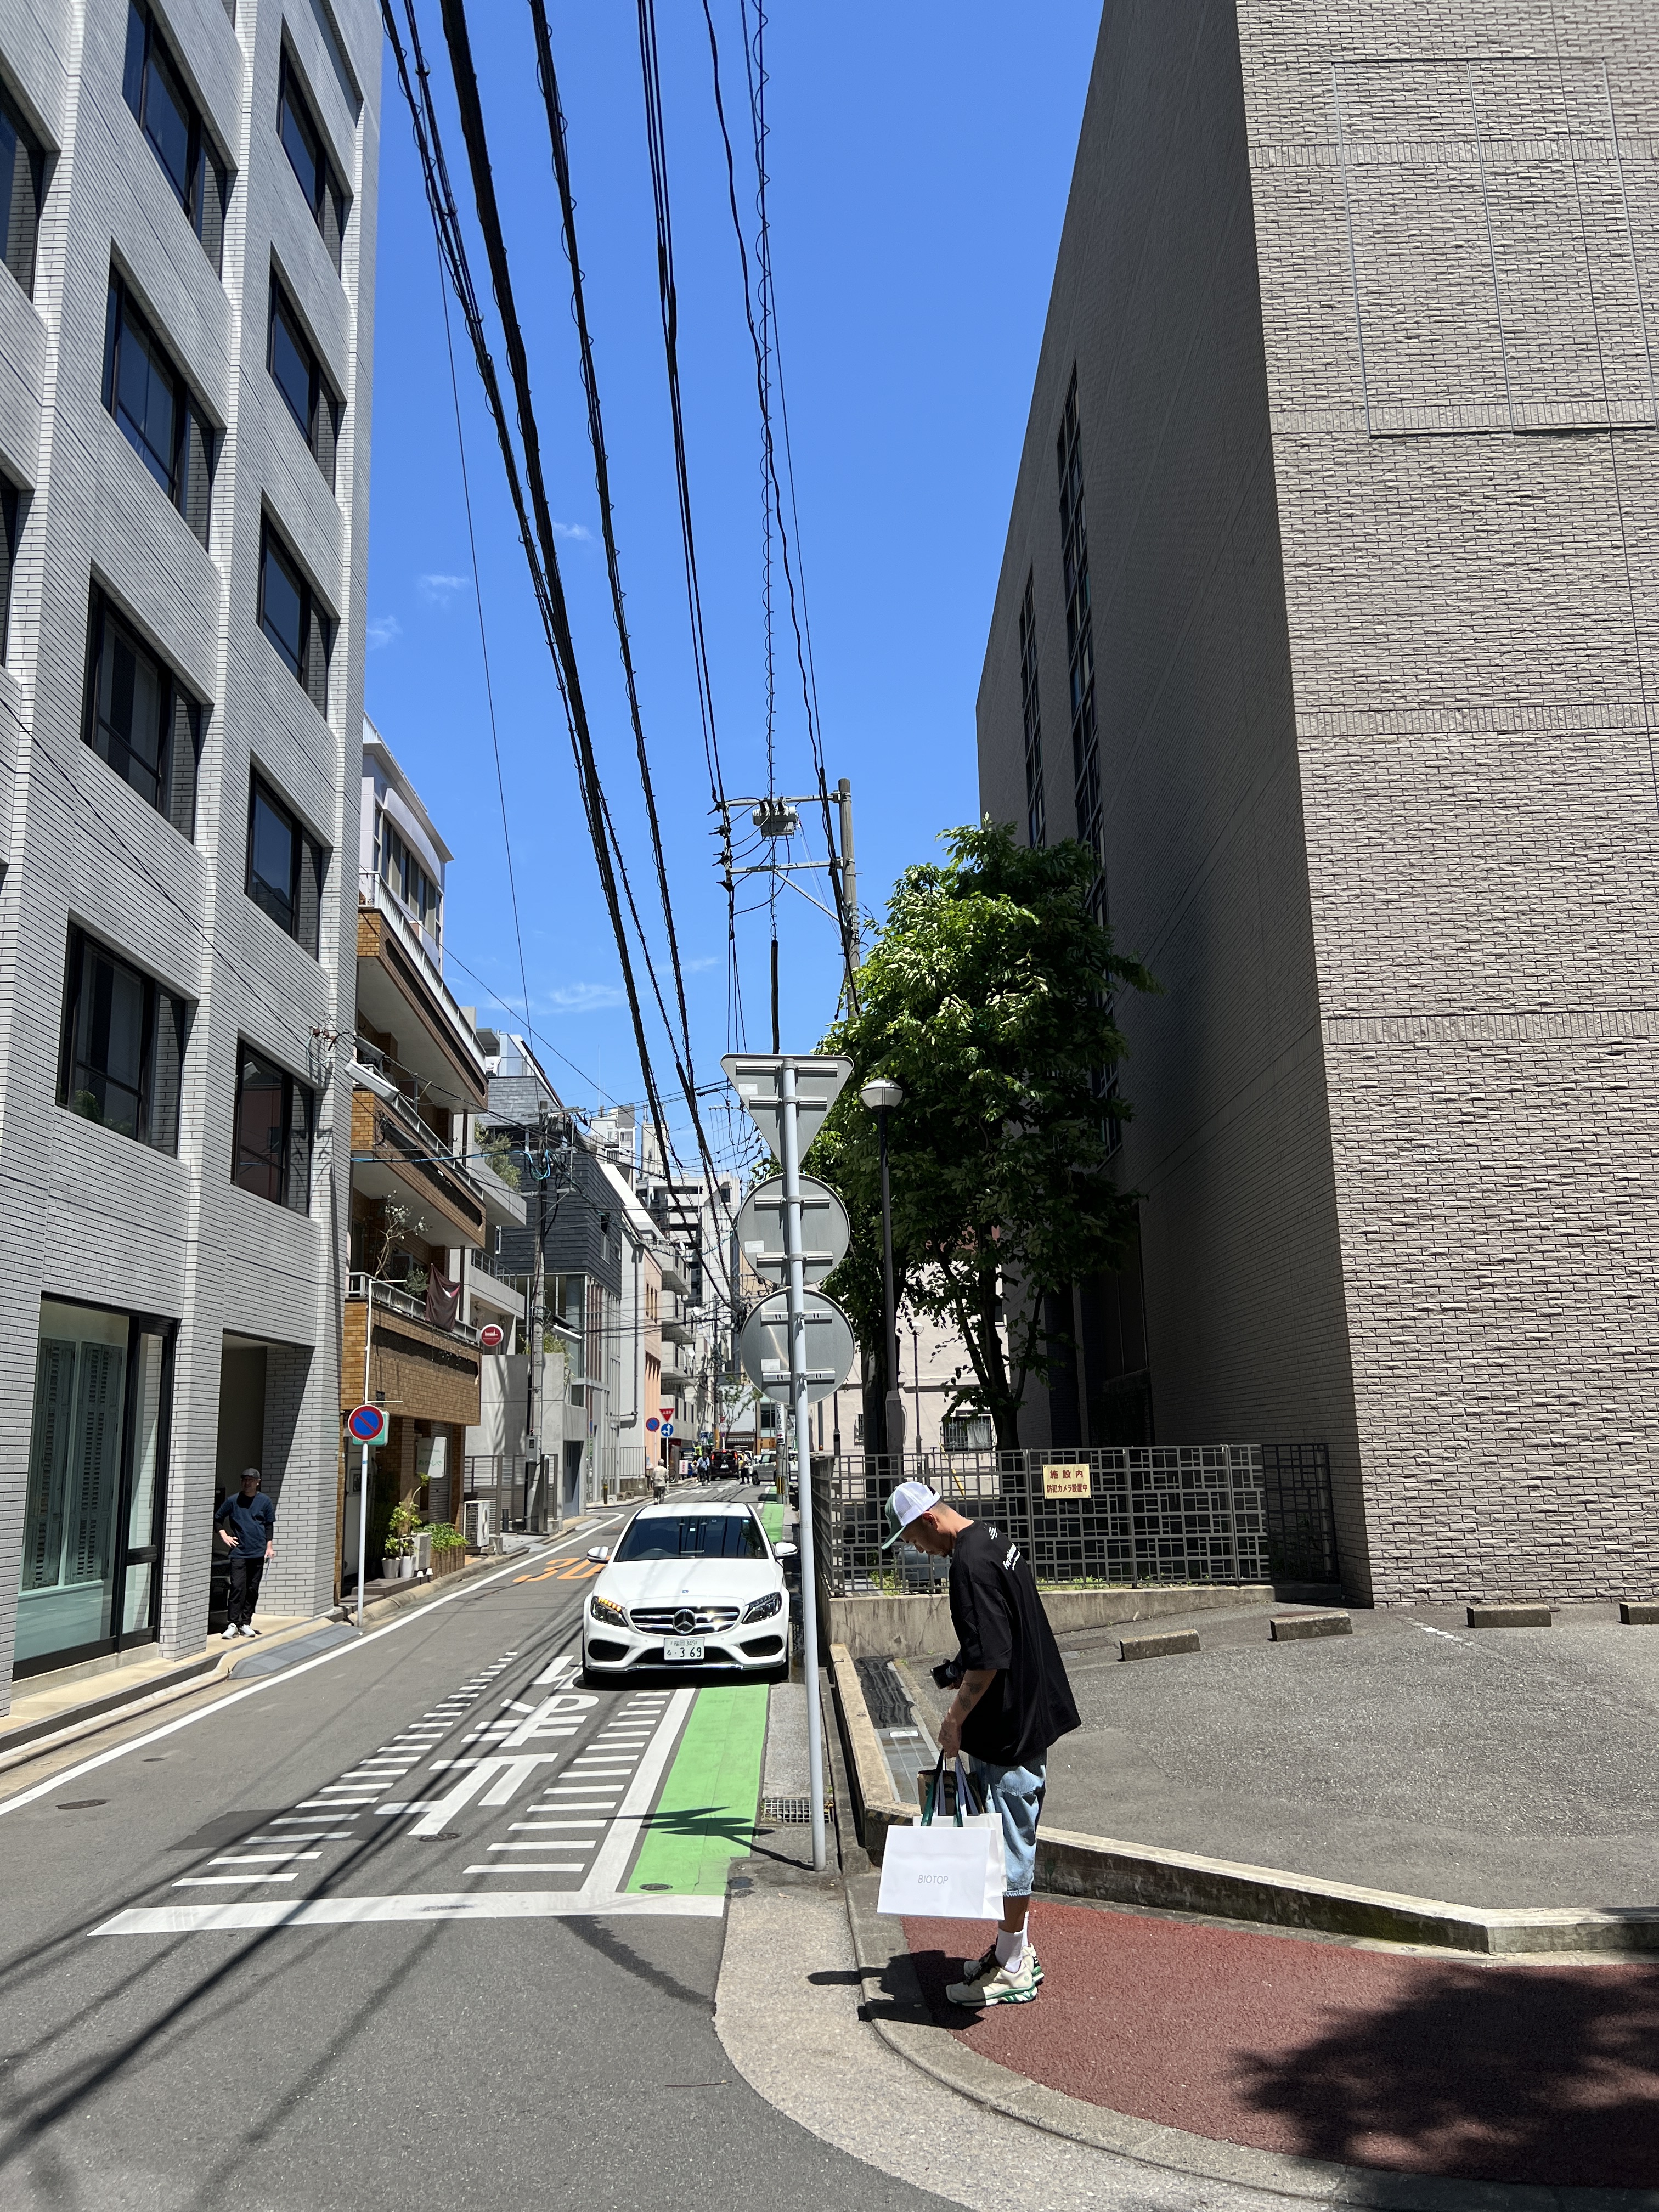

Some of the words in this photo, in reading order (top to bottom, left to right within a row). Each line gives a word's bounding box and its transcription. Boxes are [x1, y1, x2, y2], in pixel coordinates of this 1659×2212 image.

[1049, 1469, 1084, 1479] 施設内
[1046, 1483, 1088, 1493] 防犯カメラ設置中
[918, 1875, 949, 1884] BIOTOP
